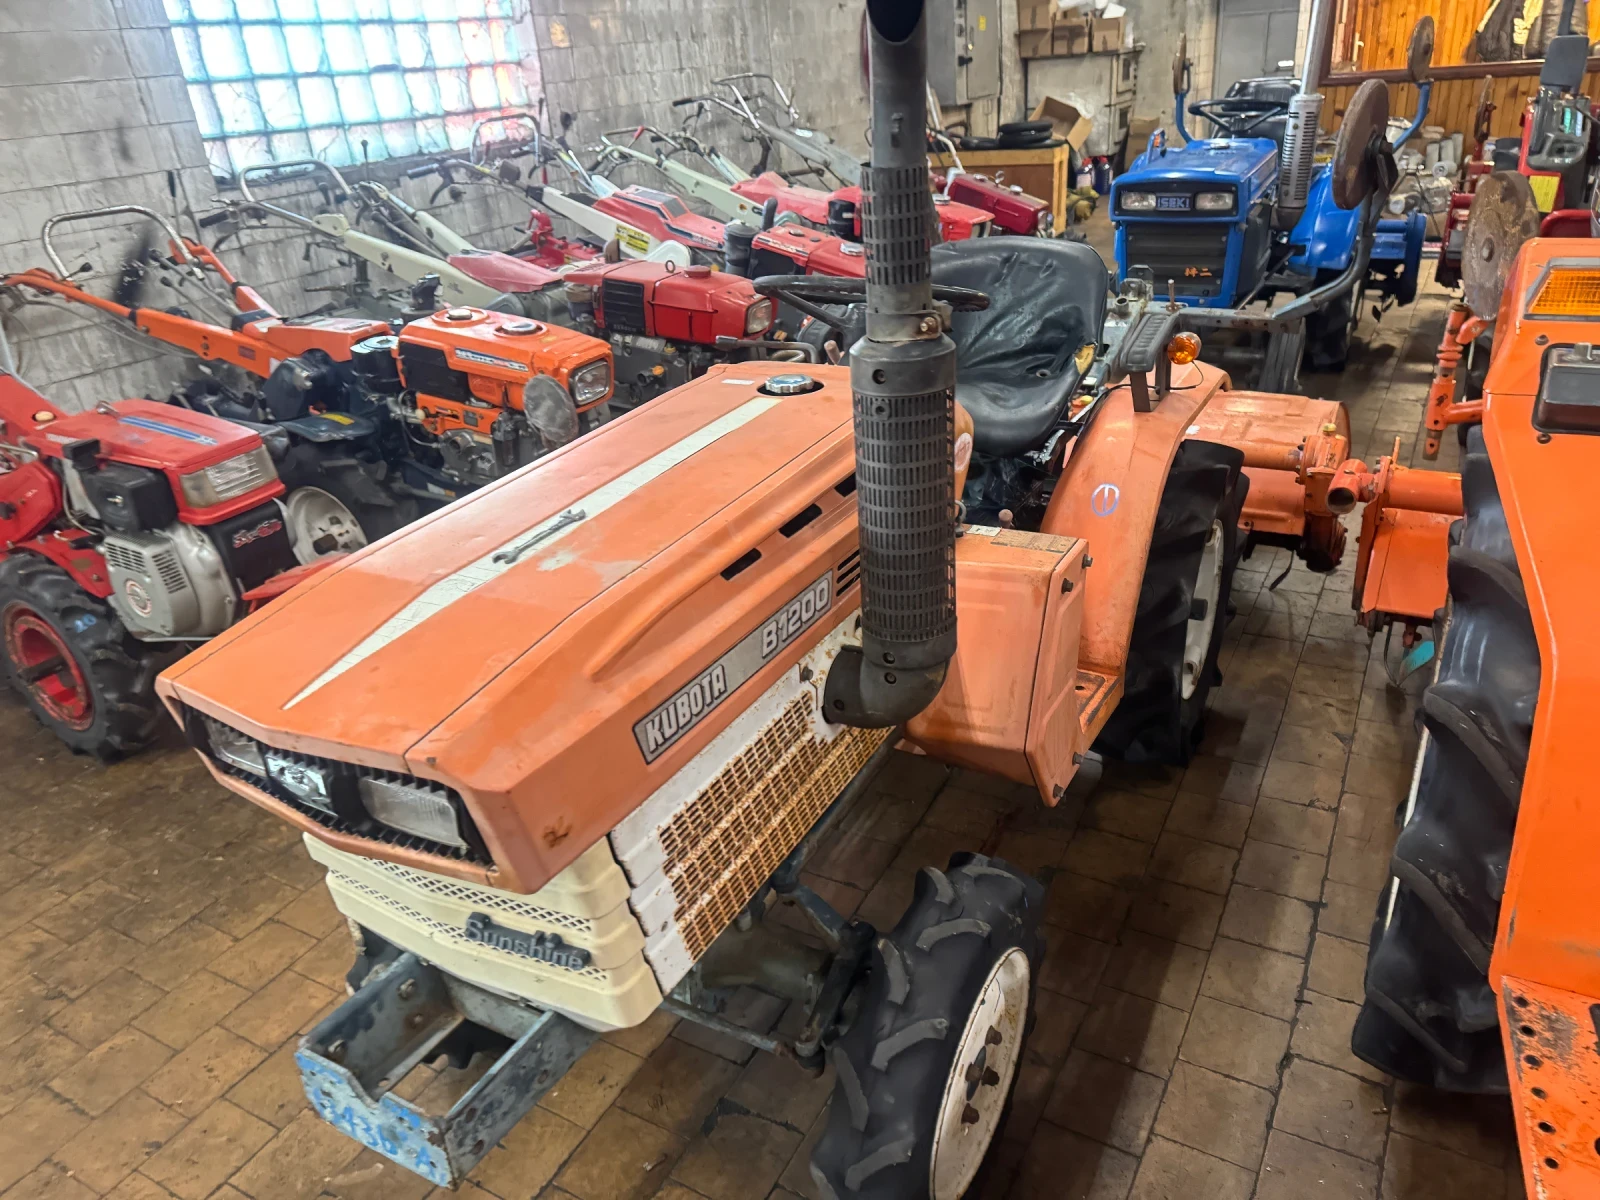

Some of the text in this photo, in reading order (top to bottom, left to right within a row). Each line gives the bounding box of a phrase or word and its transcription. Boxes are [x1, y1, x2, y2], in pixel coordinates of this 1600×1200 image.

[1157, 197, 1190, 209] ISEKI
[762, 577, 830, 659] B1200
[645, 664, 727, 753] KUBOTA
[465, 913, 588, 971] Sunshine
